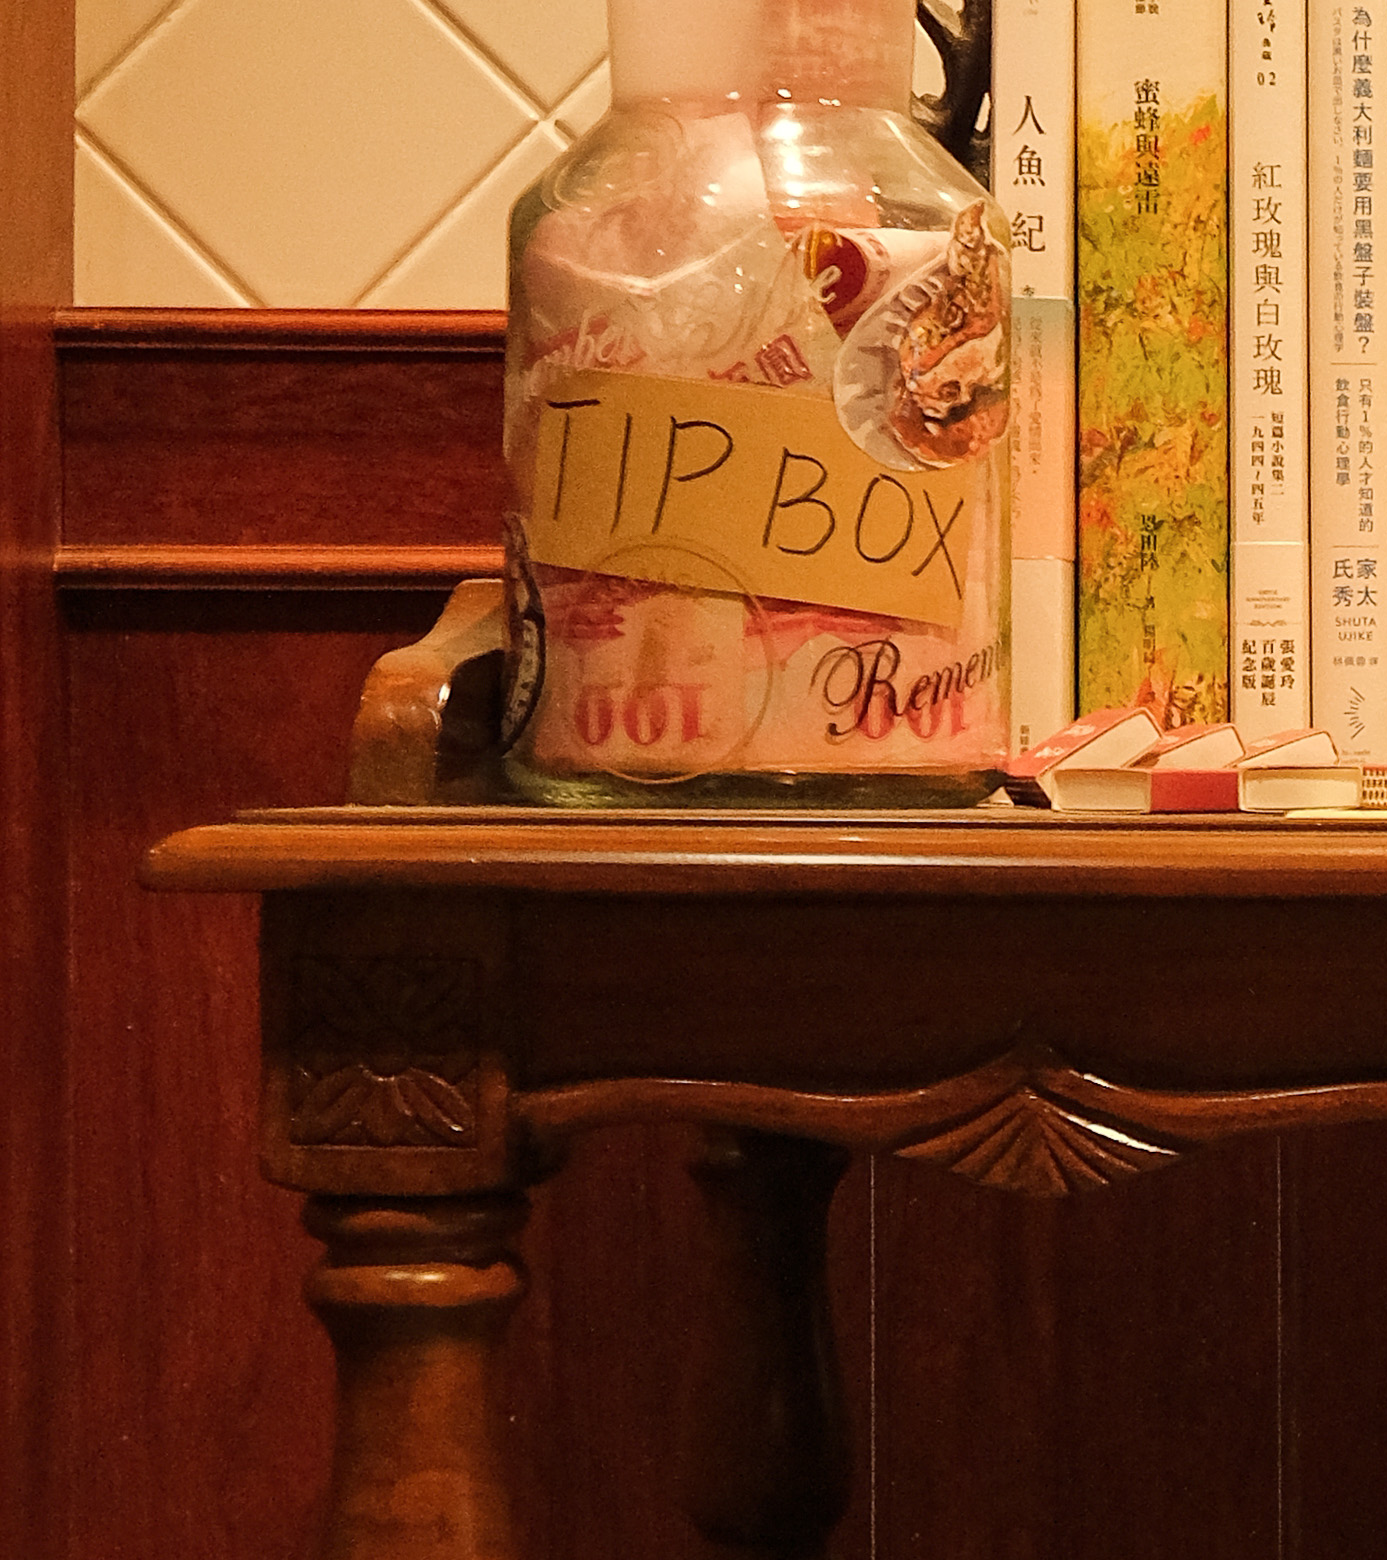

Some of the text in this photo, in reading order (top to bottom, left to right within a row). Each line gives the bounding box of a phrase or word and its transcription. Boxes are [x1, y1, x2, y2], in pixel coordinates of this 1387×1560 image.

[1256, 71, 1278, 88] 02
[1011, 94, 1047, 253] 人魚紀
[1132, 77, 1162, 217] 蜜蜂與遠雷
[1250, 160, 1285, 398] 紅玫瑰與白玫瑰
[1269, 409, 1287, 497] 短篇小說集二
[1333, 377, 1352, 488] 飲食行動心理學
[547, 397, 965, 601] TIP BOX
[1331, 558, 1379, 582] 氏家
[1331, 586, 1379, 610] 秀太
[1334, 616, 1378, 628] SHUTA
[1337, 630, 1374, 643] UJIKE
[1241, 638, 1259, 692] 紀念版
[1260, 638, 1278, 709] 百歲誕辰
[1279, 638, 1297, 692] 張愛玲
